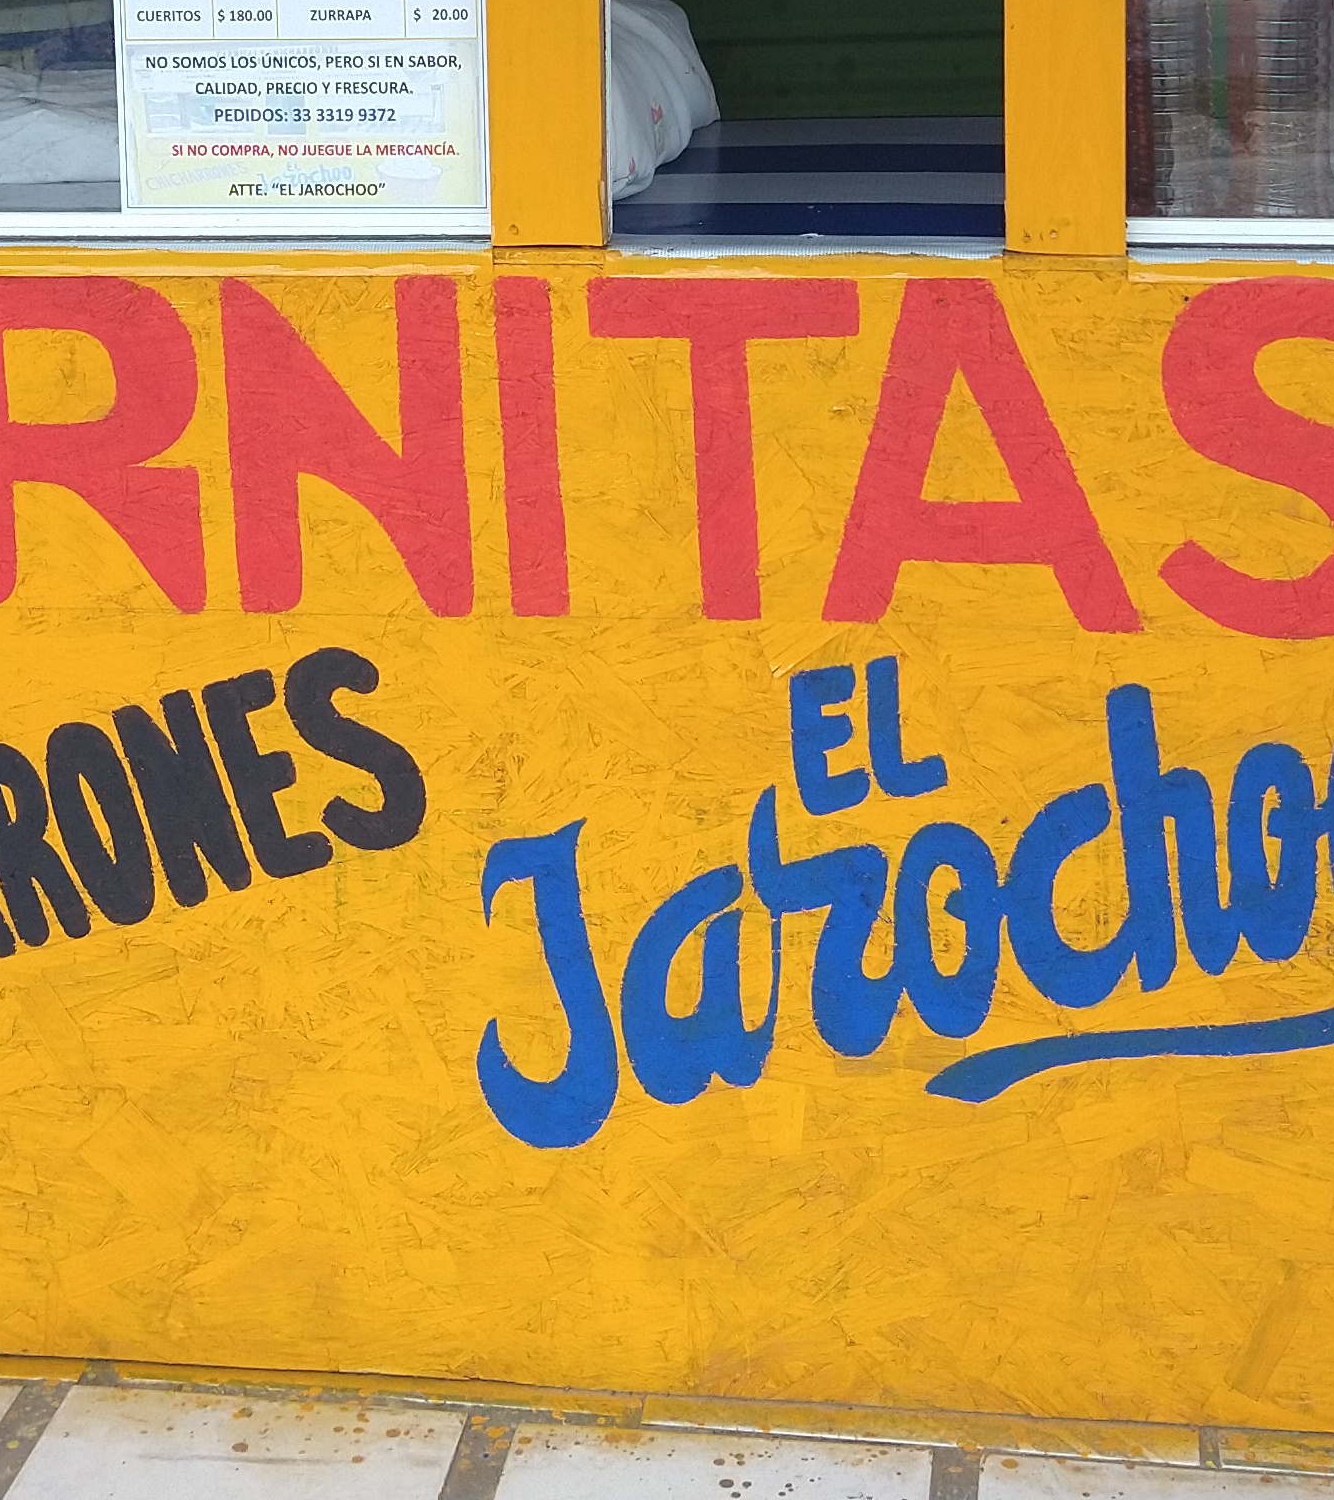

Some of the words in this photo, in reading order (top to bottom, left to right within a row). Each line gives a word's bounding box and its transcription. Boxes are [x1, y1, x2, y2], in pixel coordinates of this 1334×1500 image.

[137, 10, 201, 22] CUERITOS
[310, 9, 371, 21] ZURRAPA
[432, 9, 468, 21] 20.00
[146, 57, 168, 69] NO
[172, 56, 227, 69] SOMOS
[231, 56, 257, 69] LOS
[261, 52, 321, 71] ÚNICOS,
[326, 56, 363, 68] PERO
[368, 56, 380, 68] SI
[385, 56, 404, 68] EN
[408, 55, 462, 70] SABOR,
[195, 83, 262, 97] CALIDAD,
[266, 83, 317, 94] PRECIO
[322, 83, 331, 94] Y
[335, 82, 413, 95] FRESCURA.
[214, 109, 288, 122] PEDIDOS:
[292, 109, 311, 122] 33
[316, 109, 353, 122] 3319
[358, 109, 396, 122] 9372
[172, 145, 184, 157] SI
[188, 144, 208, 157] NO
[211, 144, 274, 159] COMPRA,
[278, 144, 298, 157] NO
[302, 144, 352, 156] JUEGUE
[356, 144, 372, 156] LA
[376, 140, 459, 156] MERCANCÍA.
[229, 183, 267, 197] ATTE.
[788, 655, 948, 816] EL
